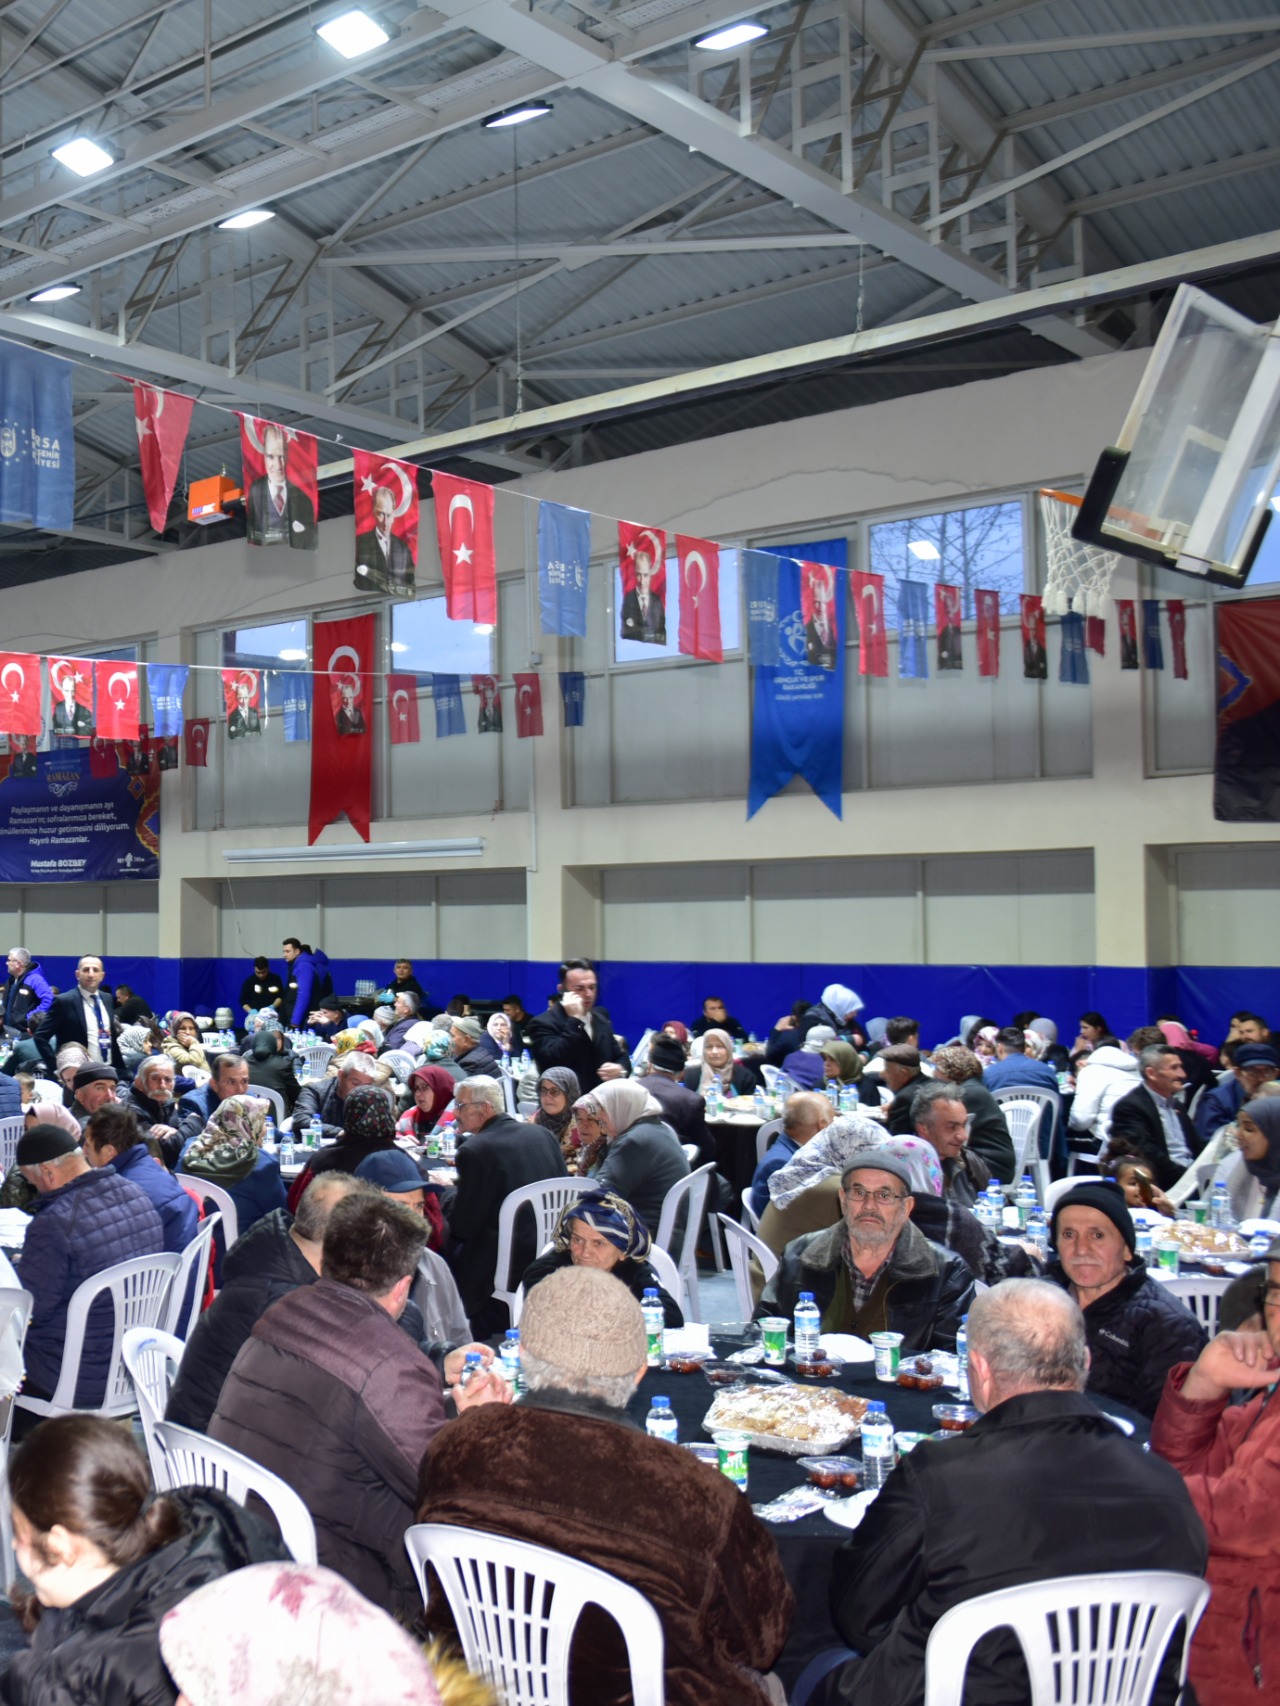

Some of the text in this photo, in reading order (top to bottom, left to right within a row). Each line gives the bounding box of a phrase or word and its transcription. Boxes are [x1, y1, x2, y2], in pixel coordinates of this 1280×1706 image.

[11, 806, 49, 815] Paylaşmanın
[59, 803, 103, 813] dayanışmanın
[47, 814, 87, 823] sofralarımıza
[39, 826, 57, 834] huzur
[58, 823, 93, 835] getirmesini
[30, 859, 87, 868] Mustafa BOZBEY
